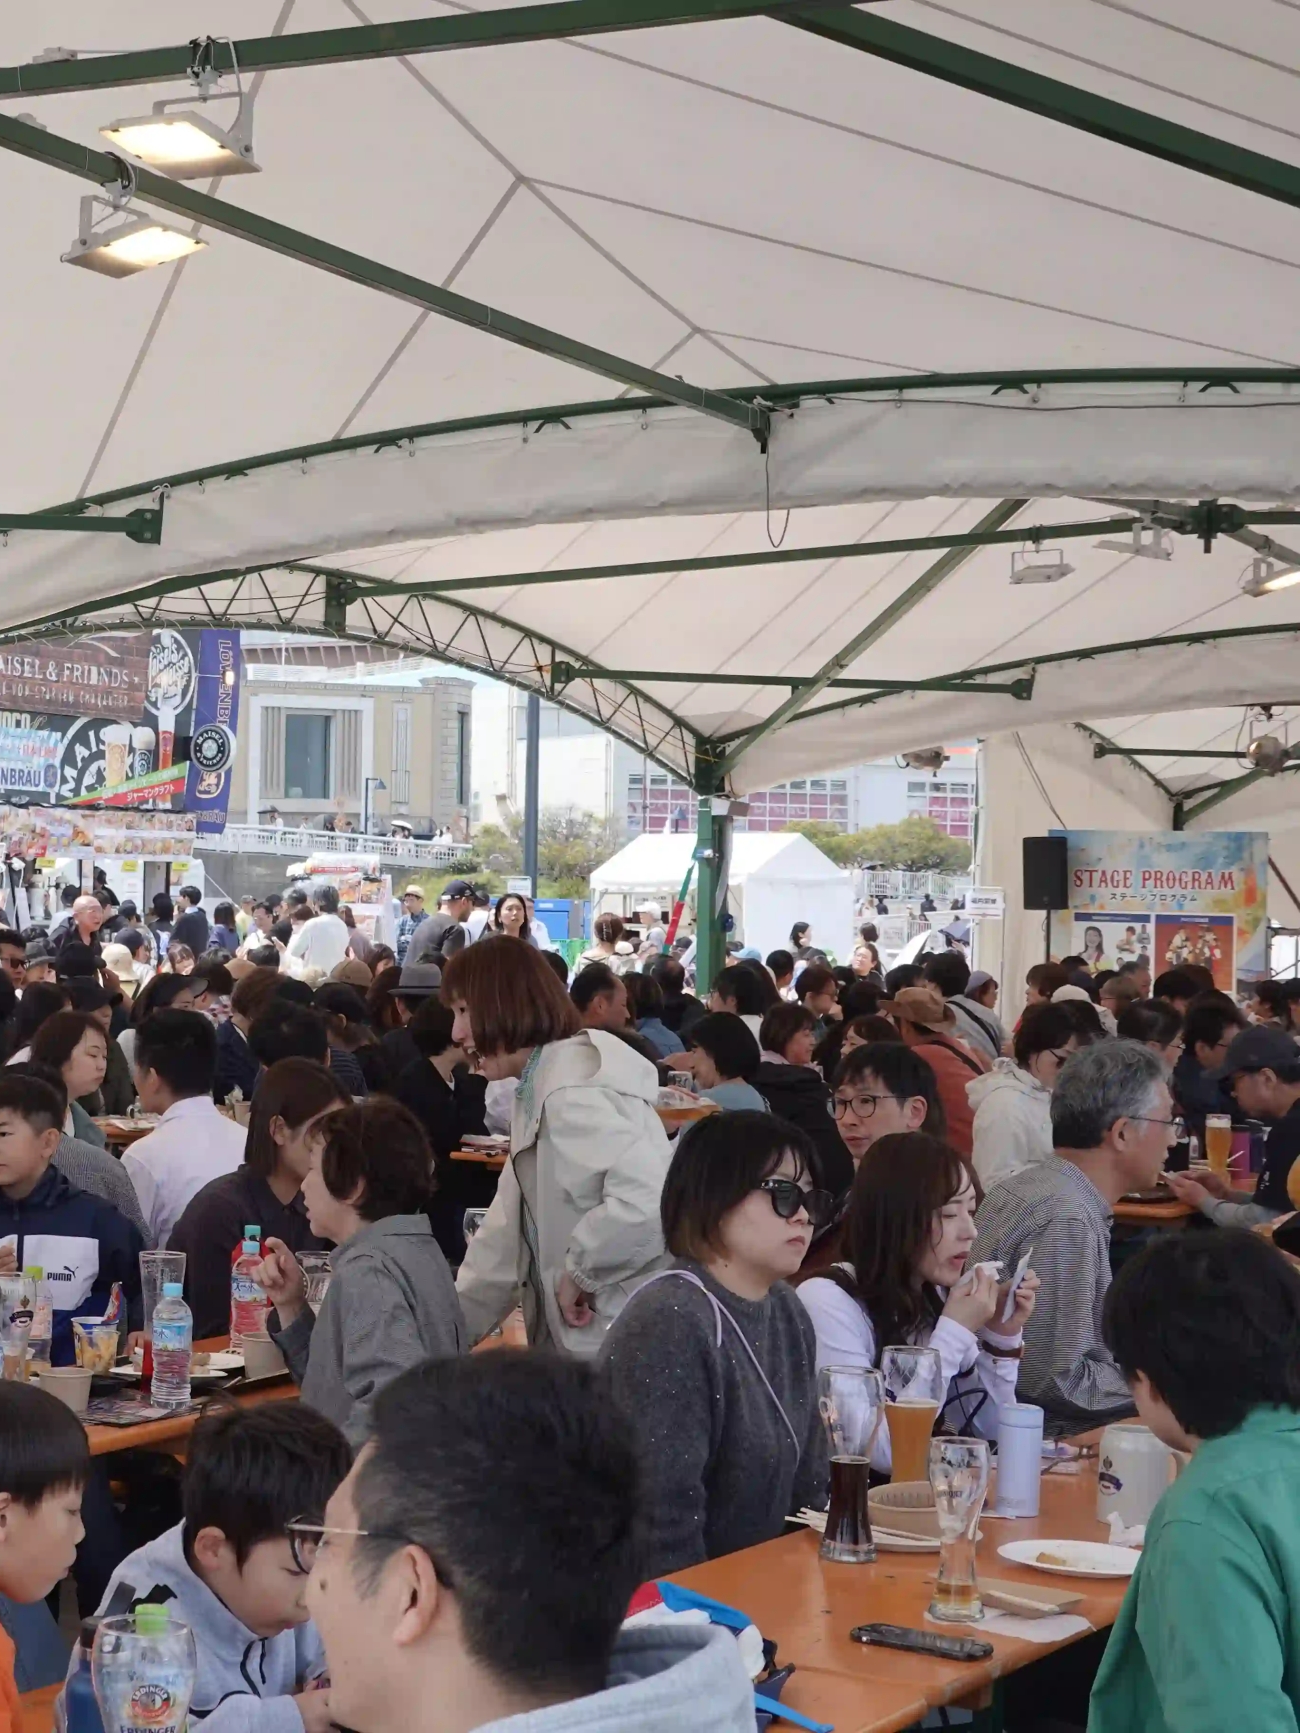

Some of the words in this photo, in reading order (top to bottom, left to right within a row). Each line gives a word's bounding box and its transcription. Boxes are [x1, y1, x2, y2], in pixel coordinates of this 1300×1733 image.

[46, 661, 58, 681] &
[196, 732, 224, 747] MAISEL
[199, 753, 223, 766] FRIENDS
[127, 784, 175, 802] ジャーマンクラフト
[1073, 869, 1133, 889] STAGE
[1141, 870, 1236, 891] PROGRAM
[1109, 892, 1198, 903] ステージプログラム
[47, 1272, 72, 1282] PUMA
[132, 1685, 168, 1700] ERDINGER
